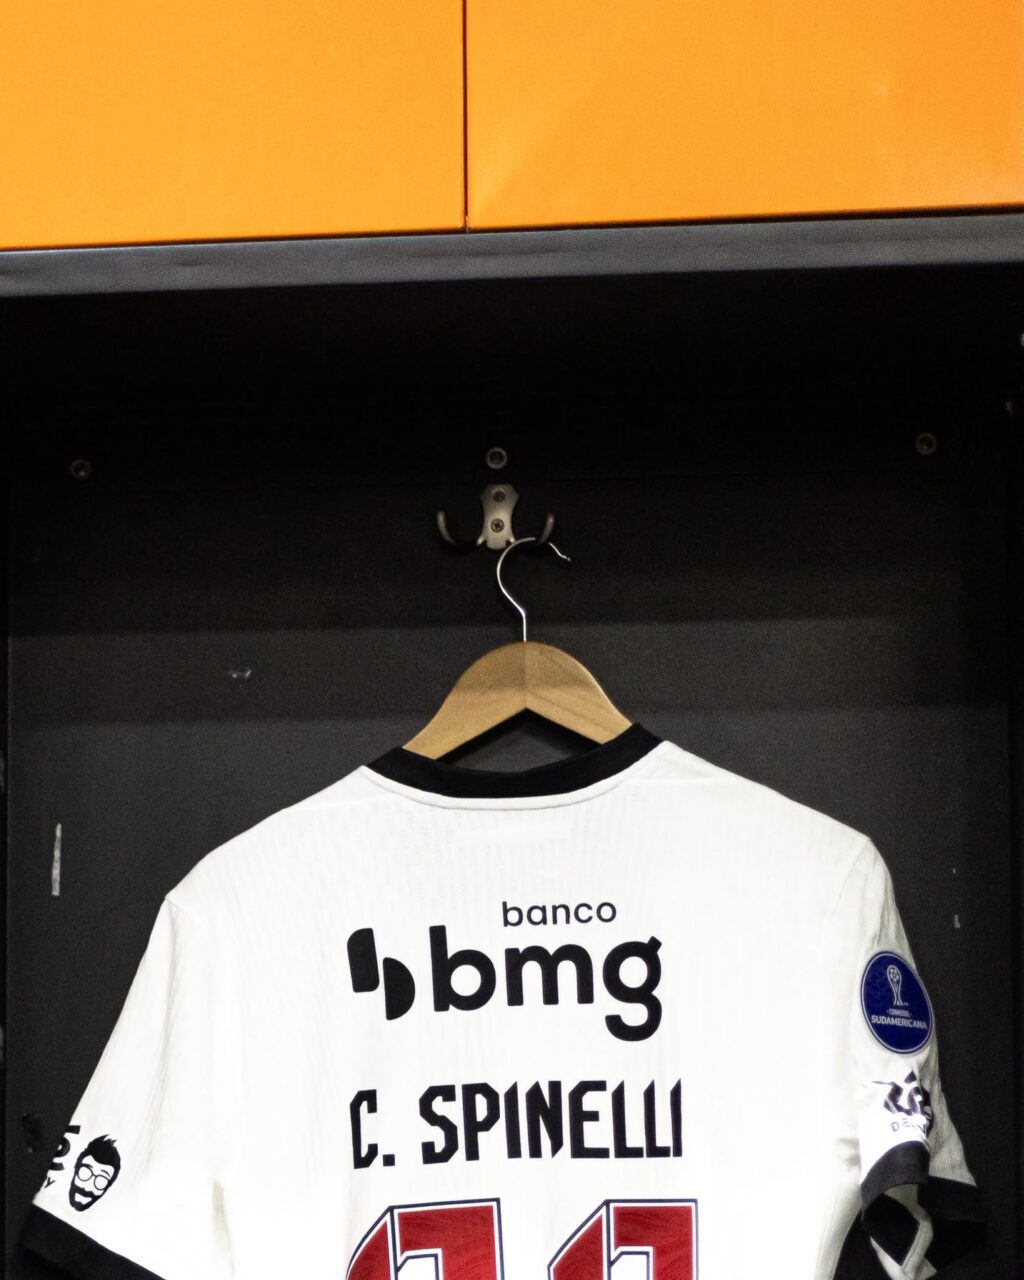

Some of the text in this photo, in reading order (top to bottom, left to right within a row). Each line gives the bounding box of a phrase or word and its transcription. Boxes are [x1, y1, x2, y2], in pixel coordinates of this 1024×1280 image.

[502, 901, 617, 927] banco
[429, 924, 662, 1042] bmg
[871, 1015, 928, 1030] SUDAMERICANA
[350, 1078, 683, 1169] C. SPINELLI
